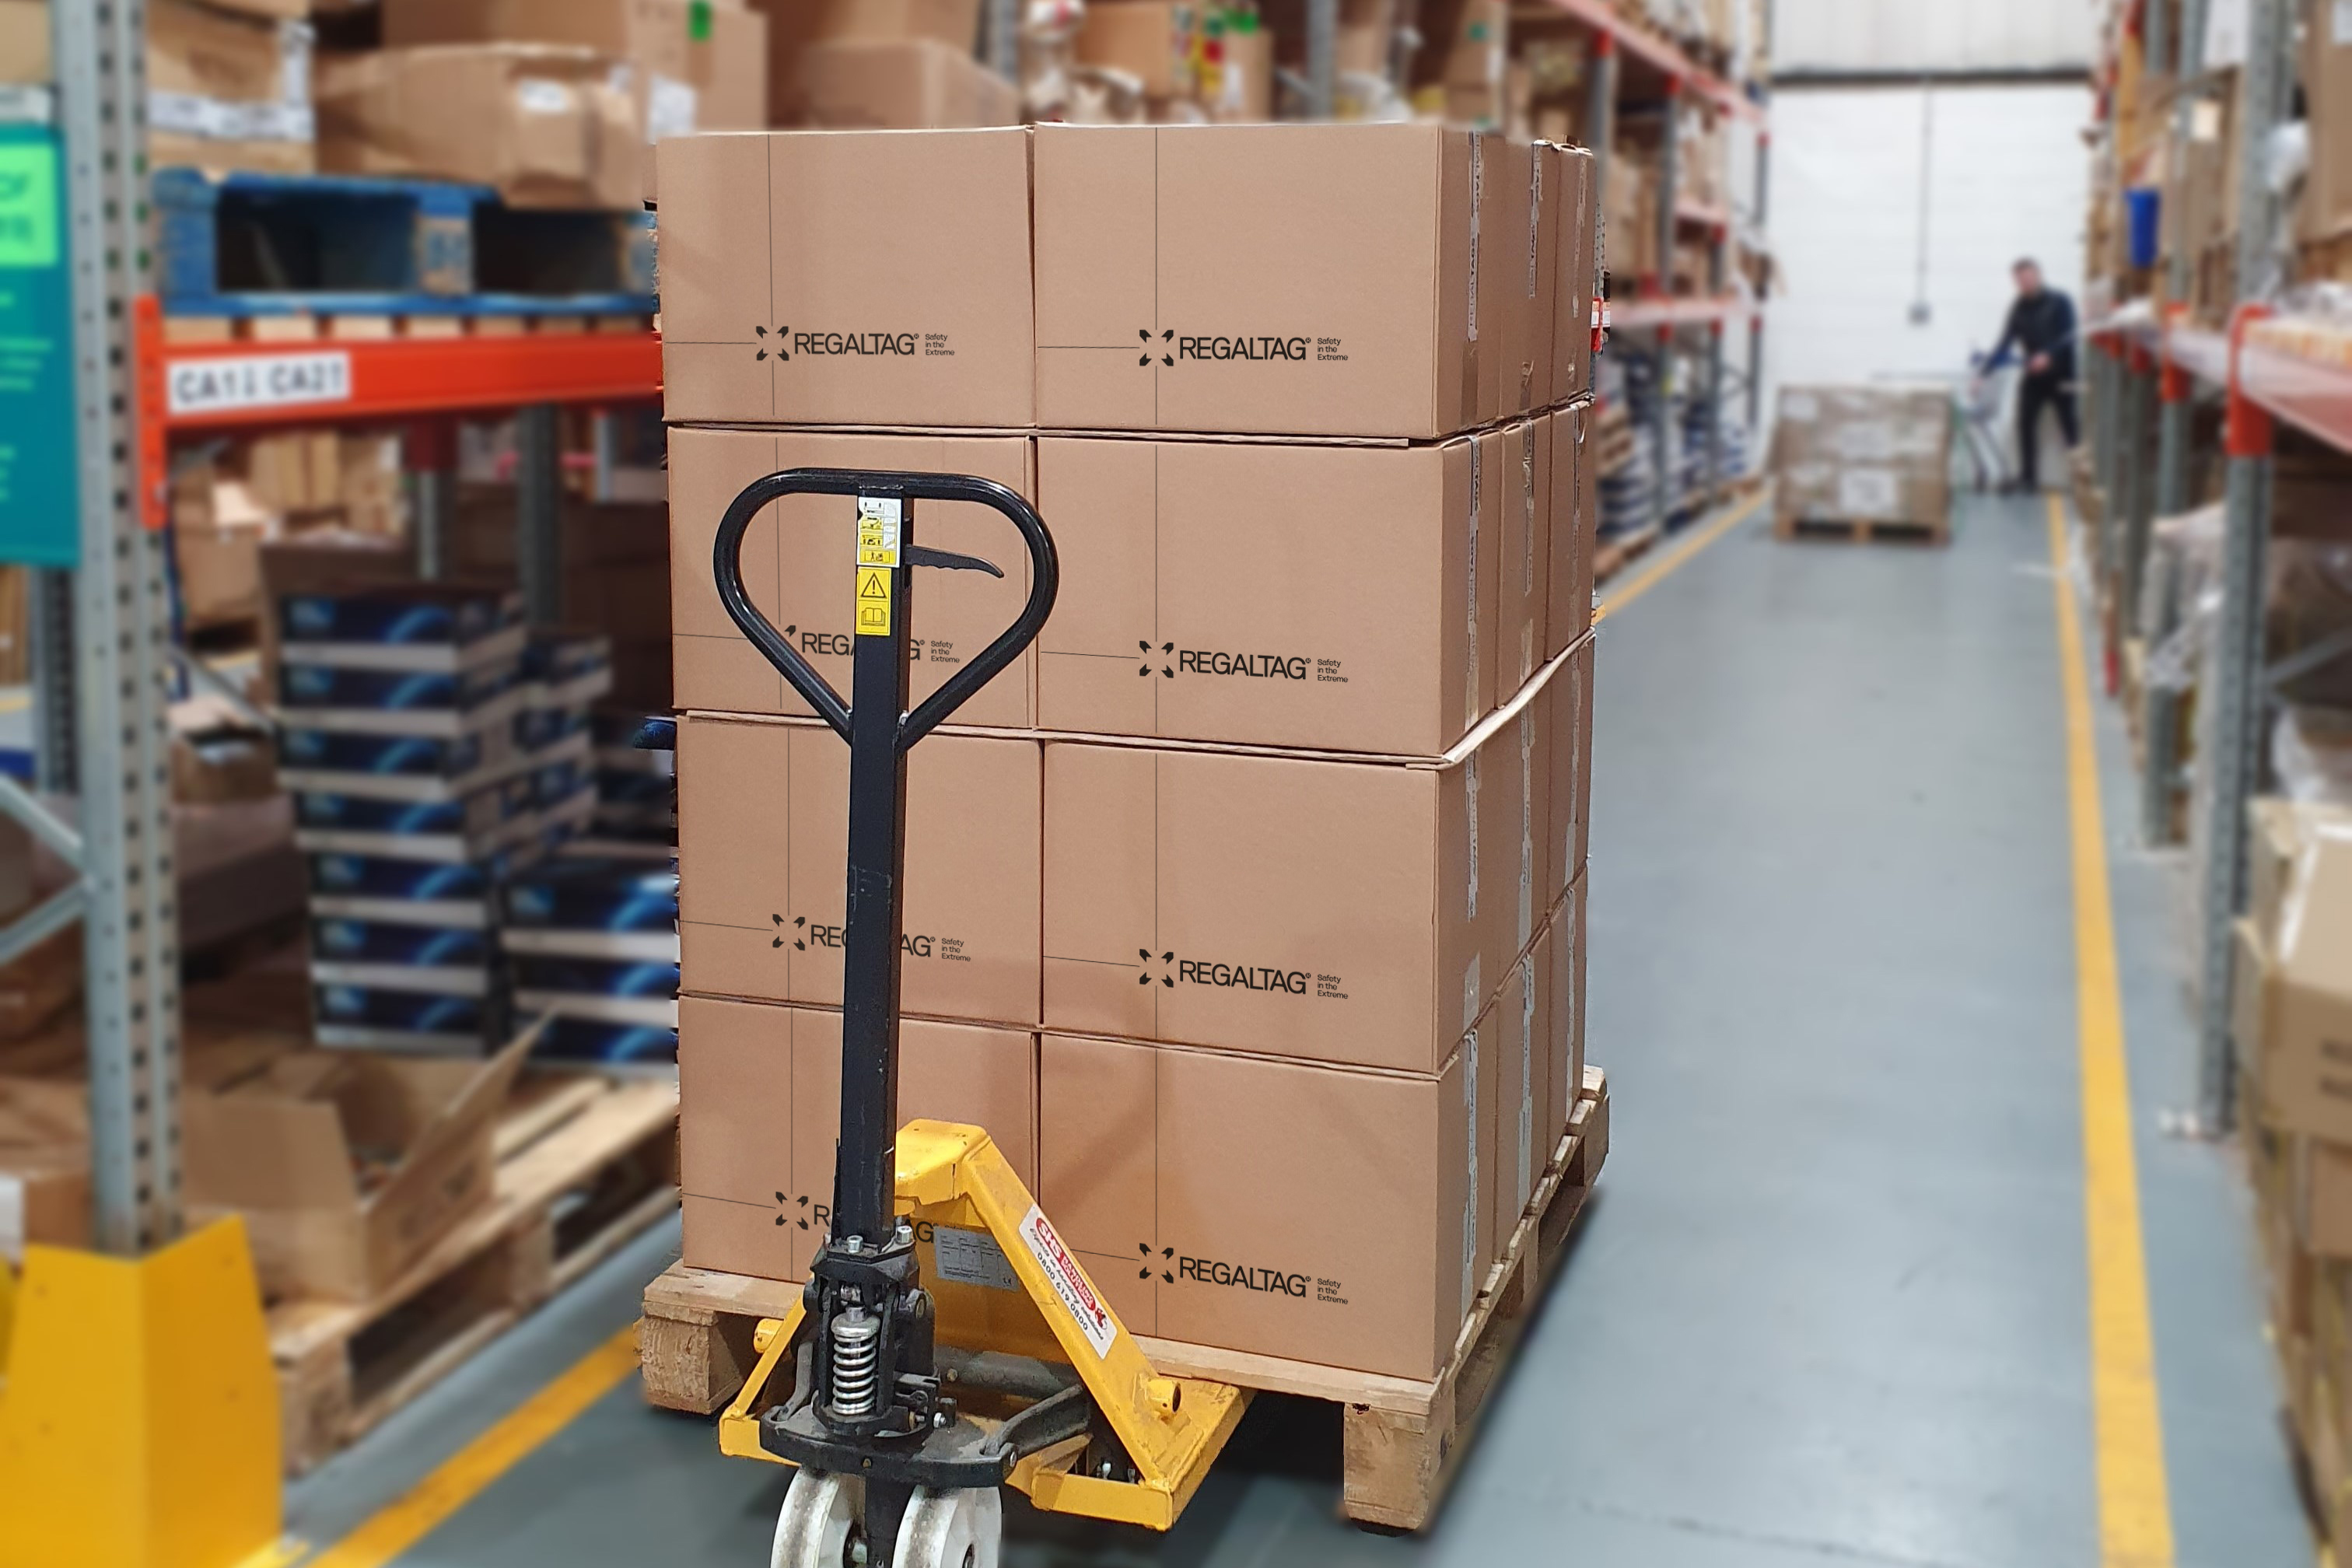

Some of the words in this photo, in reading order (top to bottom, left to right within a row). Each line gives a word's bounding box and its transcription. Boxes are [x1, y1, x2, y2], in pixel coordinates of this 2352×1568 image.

[926, 333, 947, 341] Safety
[1317, 338, 1341, 346] Safety
[931, 640, 954, 649] Safety
[931, 655, 961, 663] Extreme
[1317, 659, 1341, 668] Safety
[1317, 674, 1349, 683] Extreme
[941, 937, 964, 947] Safety
[941, 953, 971, 962] Extreme
[1317, 974, 1342, 984] Safety
[1325, 982, 1338, 991] the
[1317, 989, 1349, 999] Extreme
[1038, 1223, 1062, 1259] SHS
[1057, 1269, 1080, 1304] handling
[1317, 1278, 1342, 1289] Safety
[1038, 1251, 1055, 1279] 0800
[1055, 1283, 1070, 1301] 619
[1070, 1303, 1088, 1331] 0800
[1325, 1287, 1338, 1296] the
[1317, 1293, 1349, 1305] Extreme
